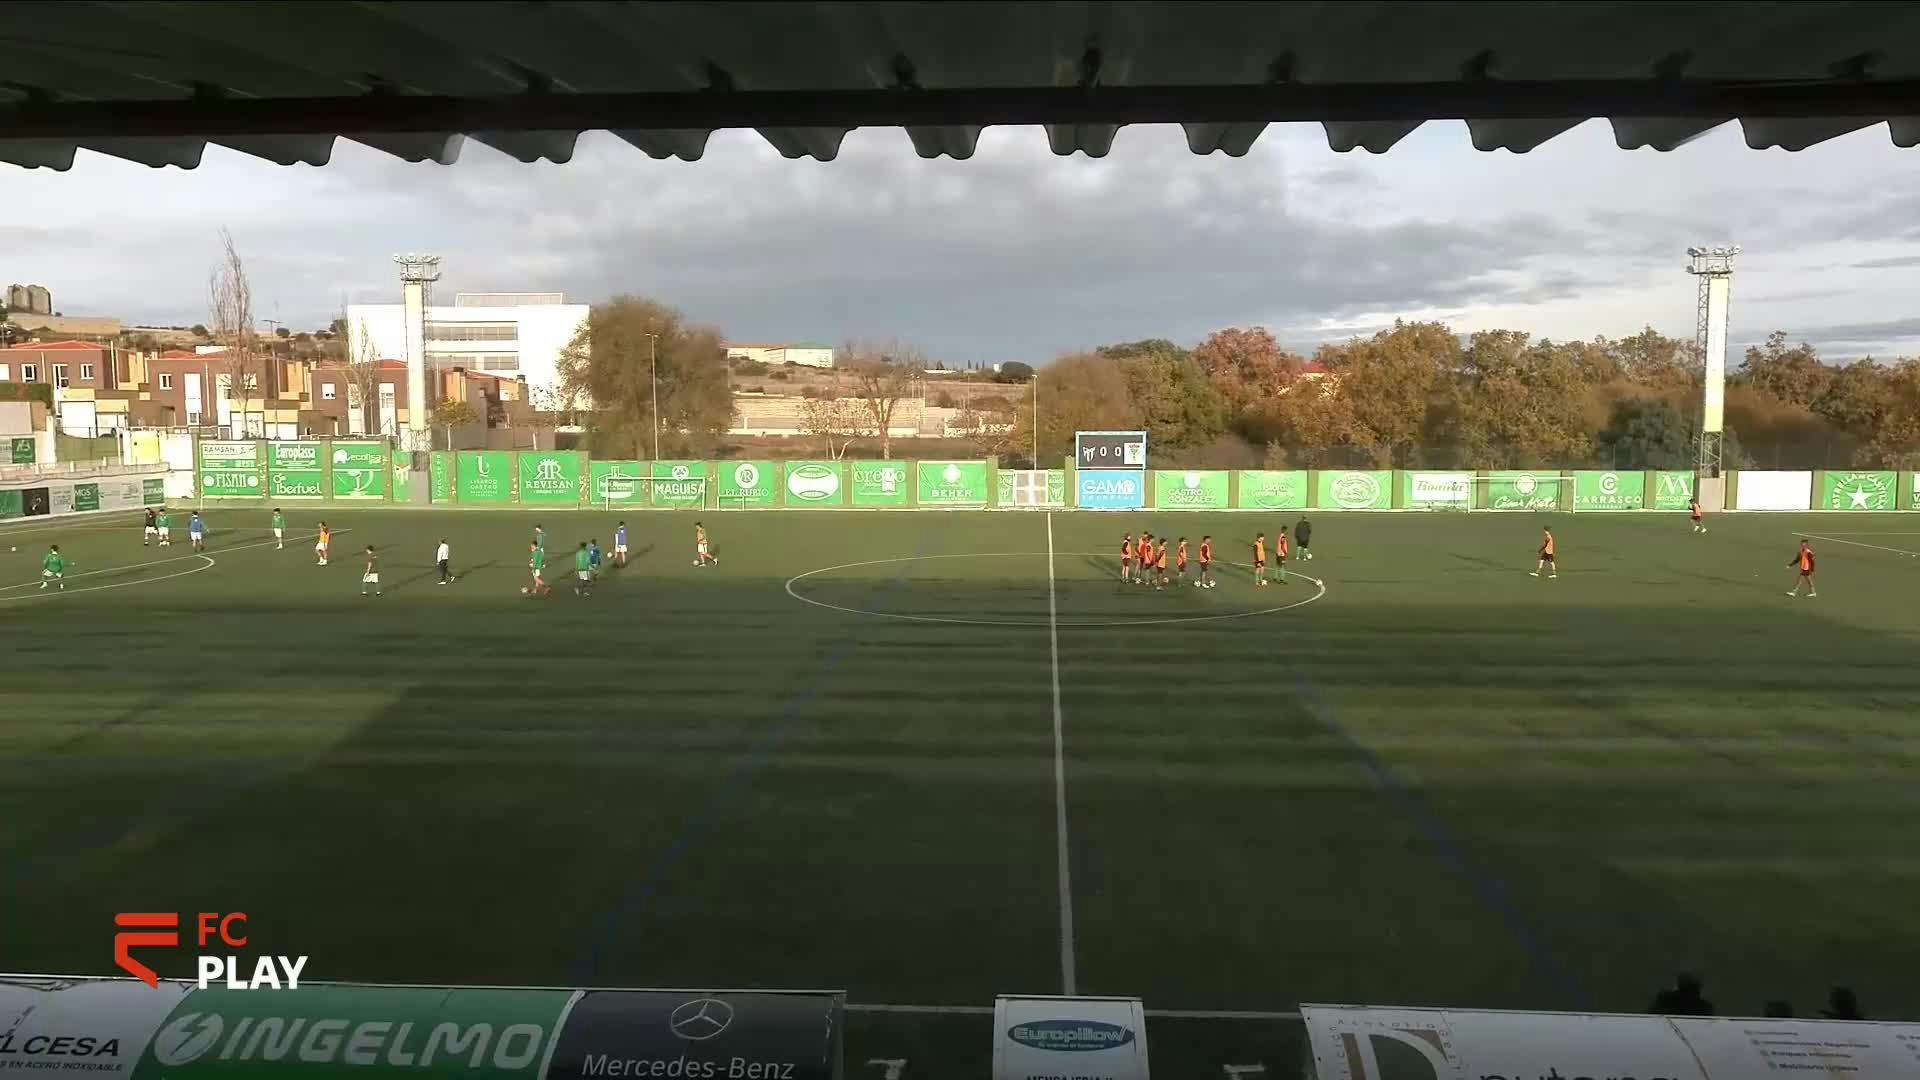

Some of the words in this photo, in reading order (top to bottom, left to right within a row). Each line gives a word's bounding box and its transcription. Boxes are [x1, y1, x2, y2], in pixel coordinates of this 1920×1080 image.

[1100, 446, 1107, 456] 0
[1114, 446, 1121, 456] 0
[526, 481, 574, 489] REVISAN
[655, 483, 705, 495] MAGUISA
[0, 1034, 120, 1056] LCESA
[221, 1016, 542, 1070] INGELMO
[582, 1053, 795, 1080] Mercedes-Benz
